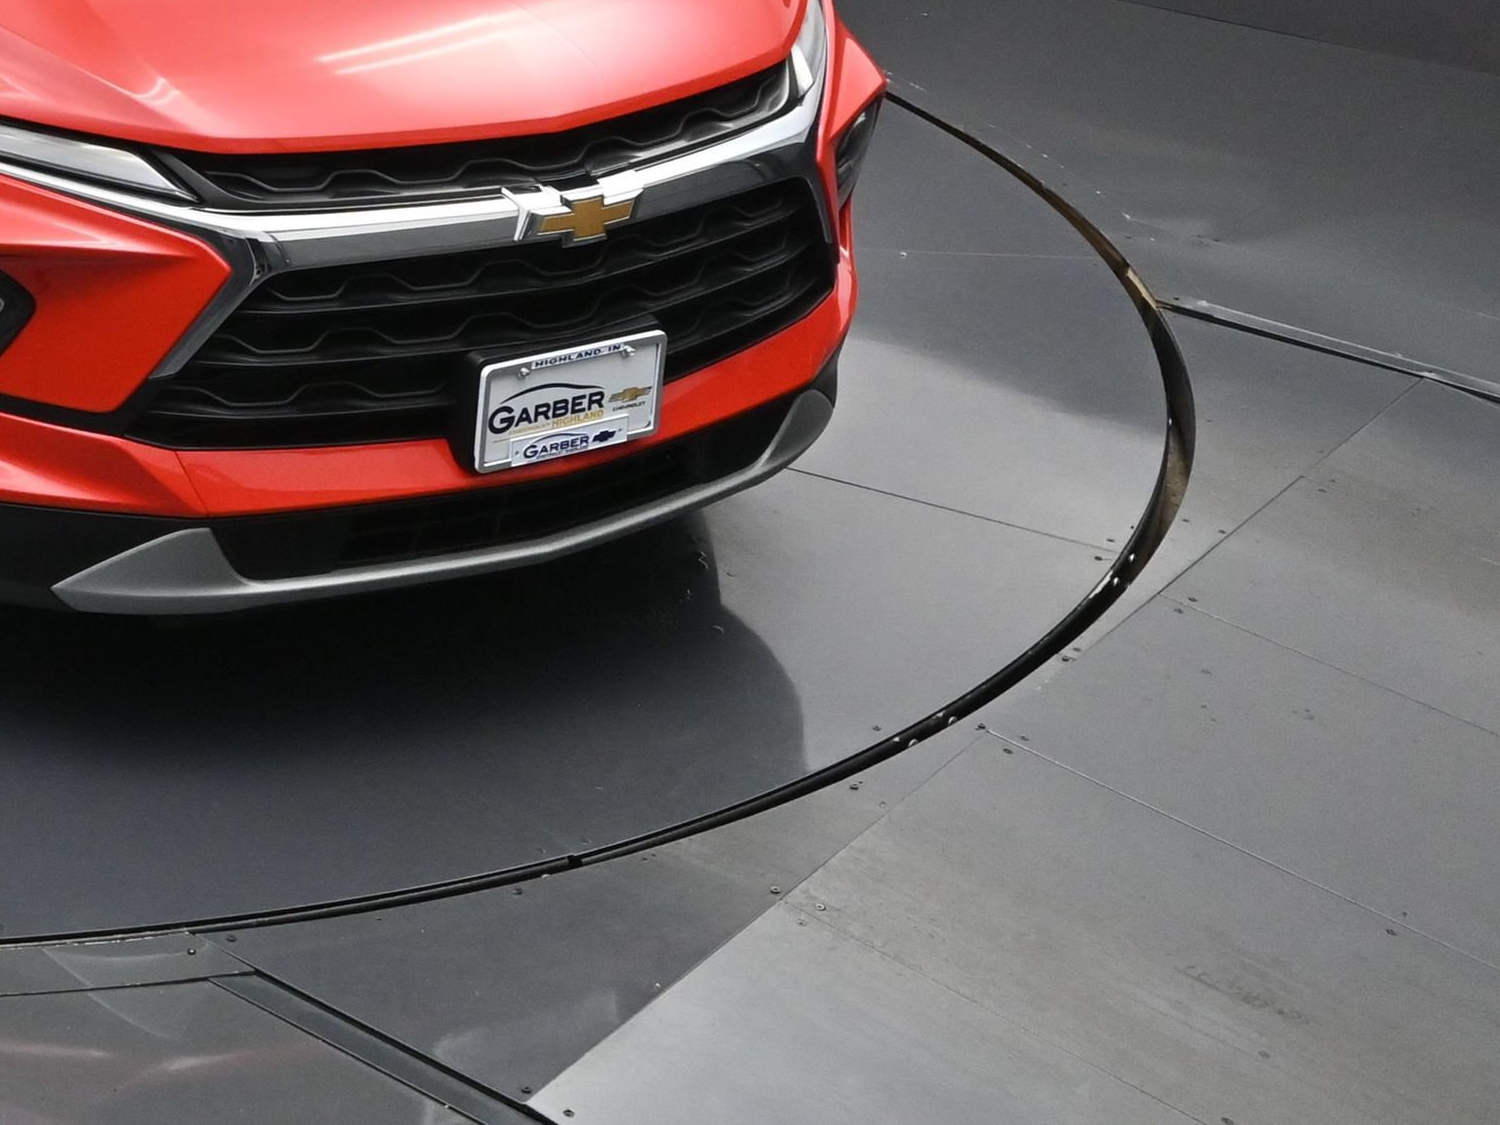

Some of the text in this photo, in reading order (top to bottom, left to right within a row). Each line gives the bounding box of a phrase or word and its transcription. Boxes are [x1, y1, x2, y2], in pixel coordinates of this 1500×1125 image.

[608, 343, 621, 352] IN
[488, 390, 605, 434] GARBER
[552, 410, 604, 428] HIGHLAND
[523, 436, 590, 459] GARBER
